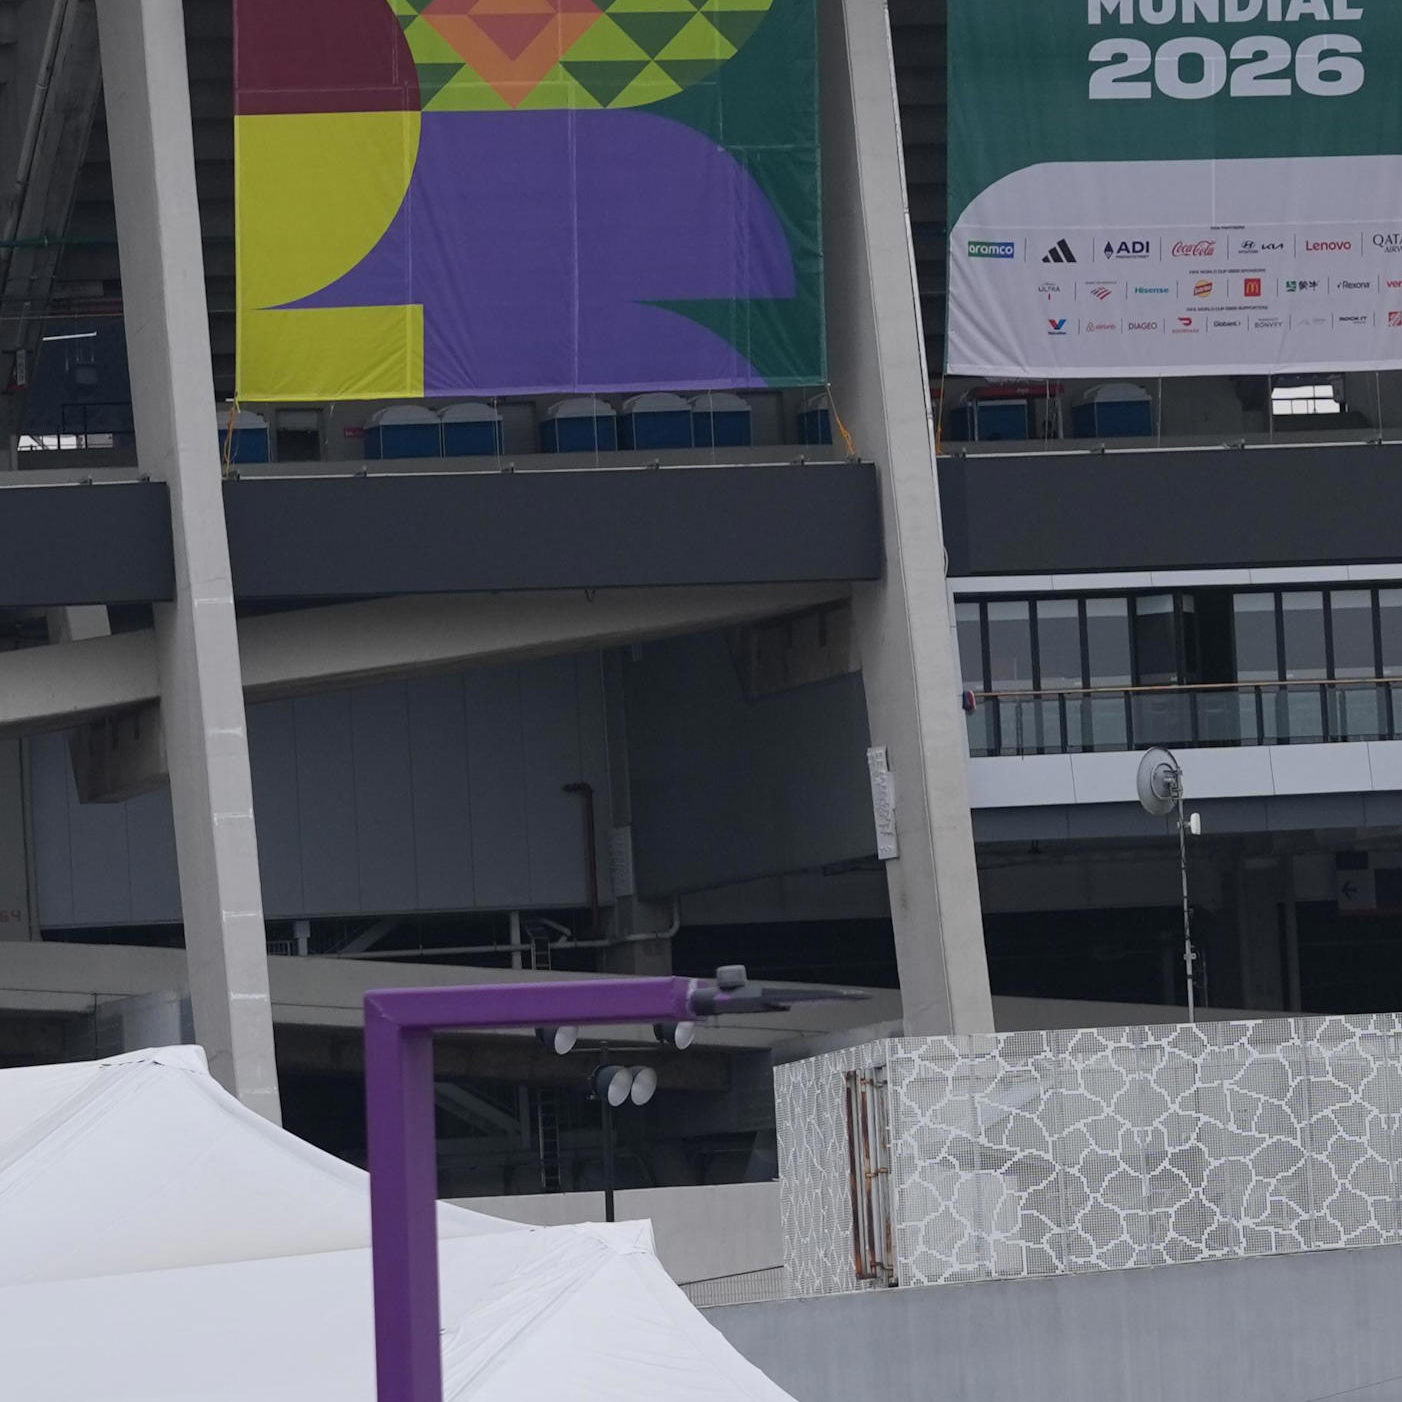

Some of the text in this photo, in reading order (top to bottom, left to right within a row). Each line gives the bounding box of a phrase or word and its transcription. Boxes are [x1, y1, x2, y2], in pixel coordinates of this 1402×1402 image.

[1088, 34, 1365, 100] 2026
[969, 243, 1013, 257] aramco
[1116, 241, 1150, 254] ADI
[1305, 240, 1352, 252] Lenovo
[1134, 286, 1169, 295] Hisense
[1342, 280, 1370, 290] Rexona
[1128, 322, 1157, 331] DIAGEO
